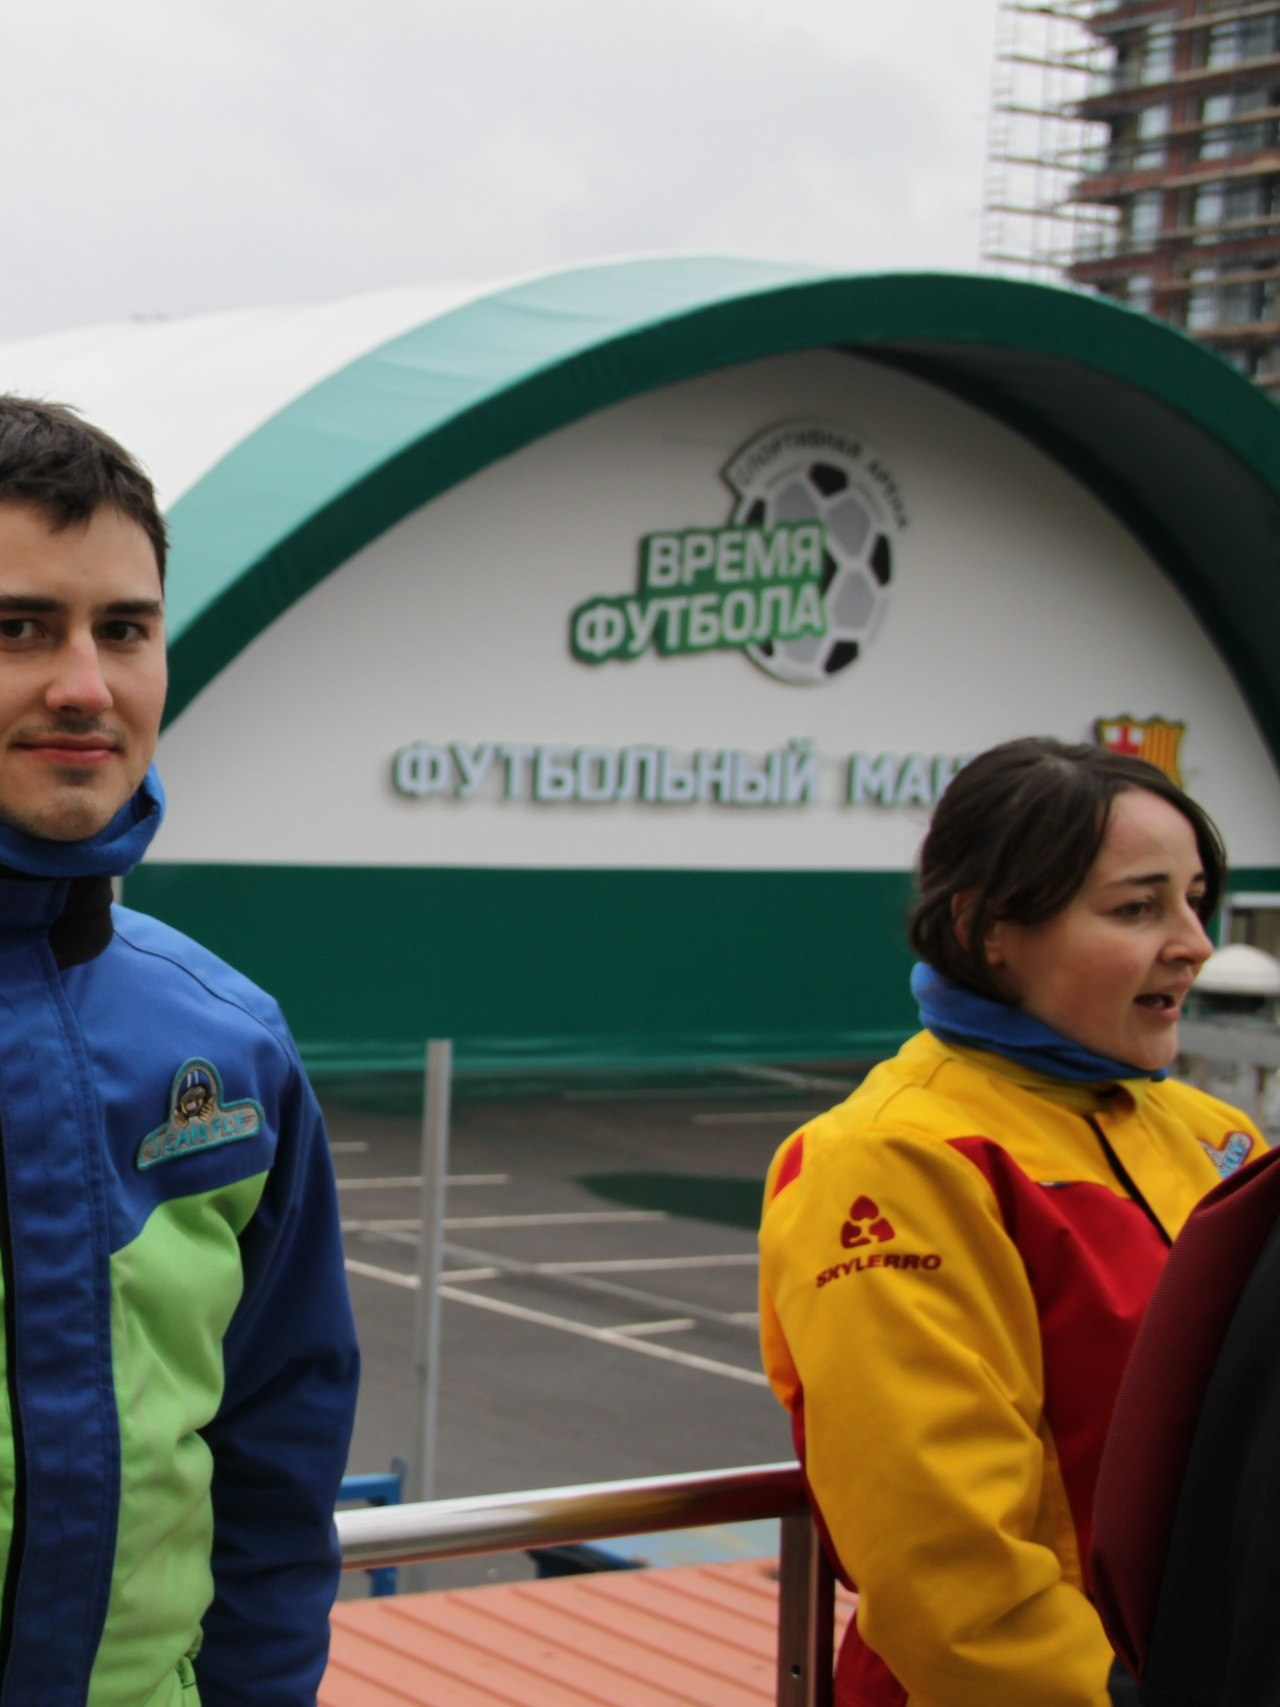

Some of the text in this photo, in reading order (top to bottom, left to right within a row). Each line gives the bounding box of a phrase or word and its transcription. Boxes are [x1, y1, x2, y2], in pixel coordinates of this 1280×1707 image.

[734, 426, 862, 485] СПОРТИВНАЯ
[646, 526, 824, 588] ВРЕМЯ
[575, 582, 825, 656] ФУТБОЛА
[392, 736, 818, 804] ФУТБОЛЬНЫЙ
[162, 1120, 208, 1151] CAN
[211, 1111, 246, 1138] FLY
[815, 1254, 942, 1289] SKYLERRO
